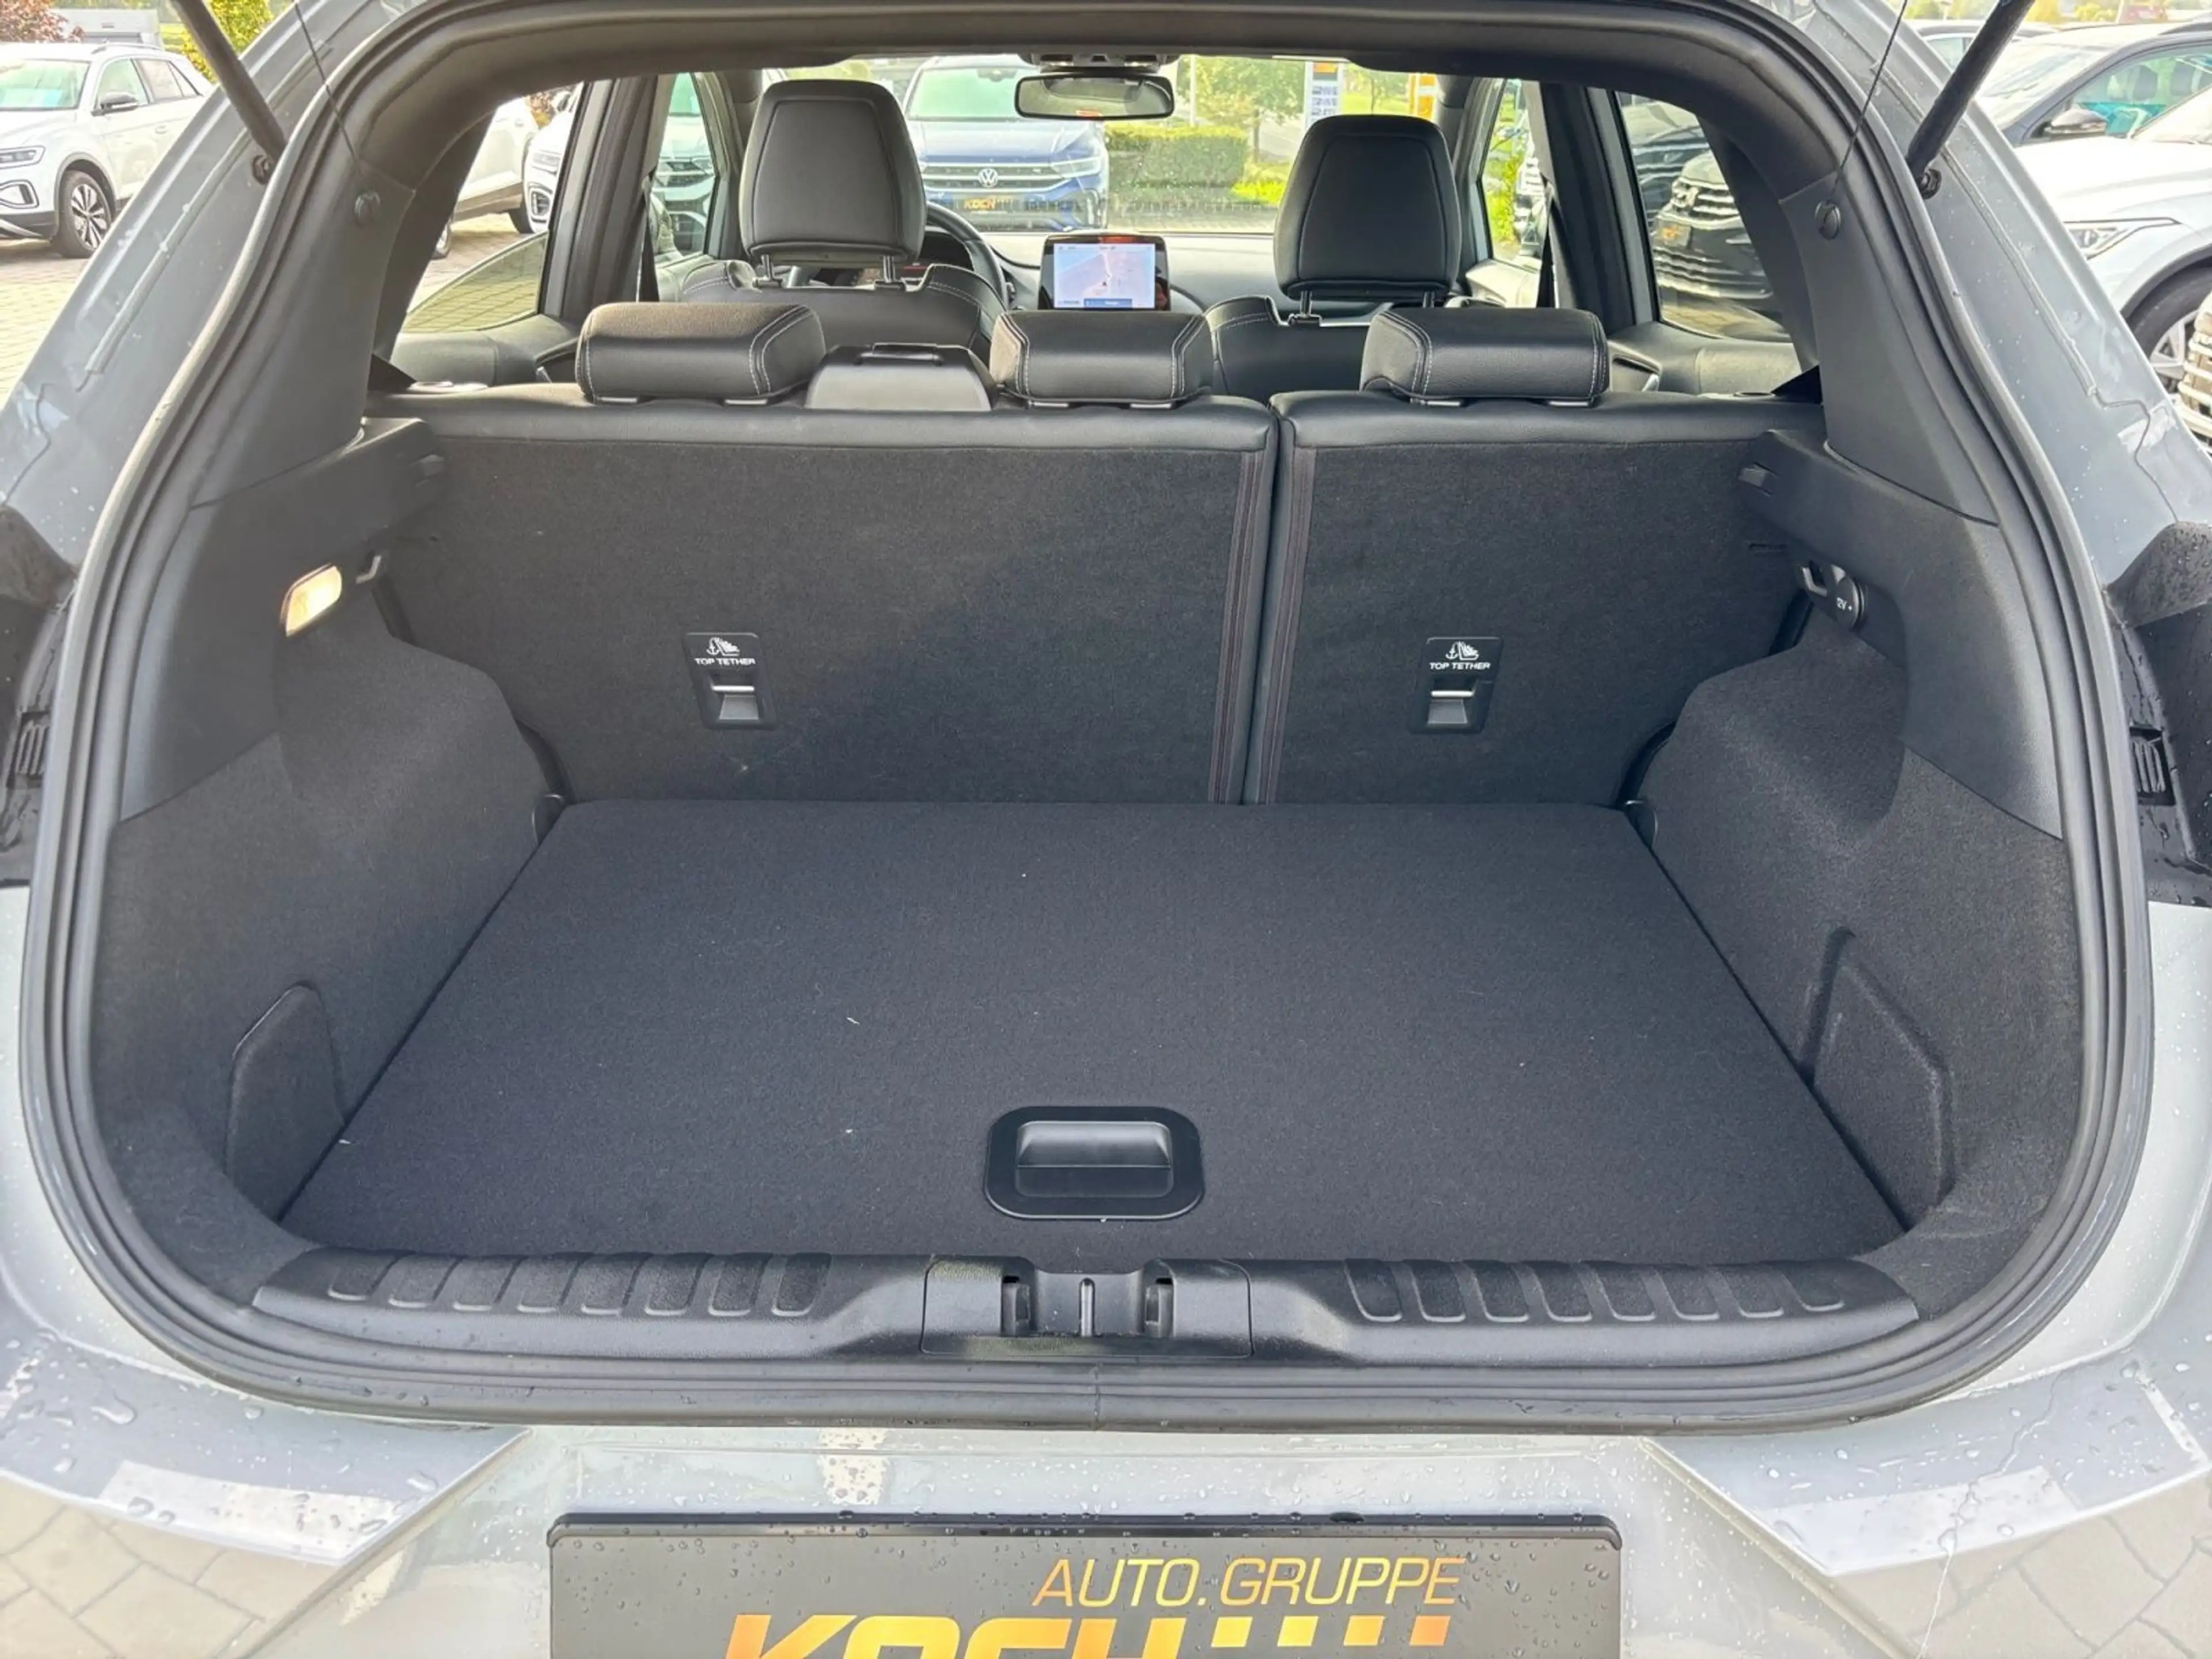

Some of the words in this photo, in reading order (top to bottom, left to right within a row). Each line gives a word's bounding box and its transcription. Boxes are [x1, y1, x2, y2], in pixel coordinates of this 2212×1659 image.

[717, 658, 756, 666] TETHER
[1430, 662, 1449, 670] TOP
[1452, 662, 1491, 670] TETHER
[1032, 1557, 1465, 1607] AUTO.GRUPPE
